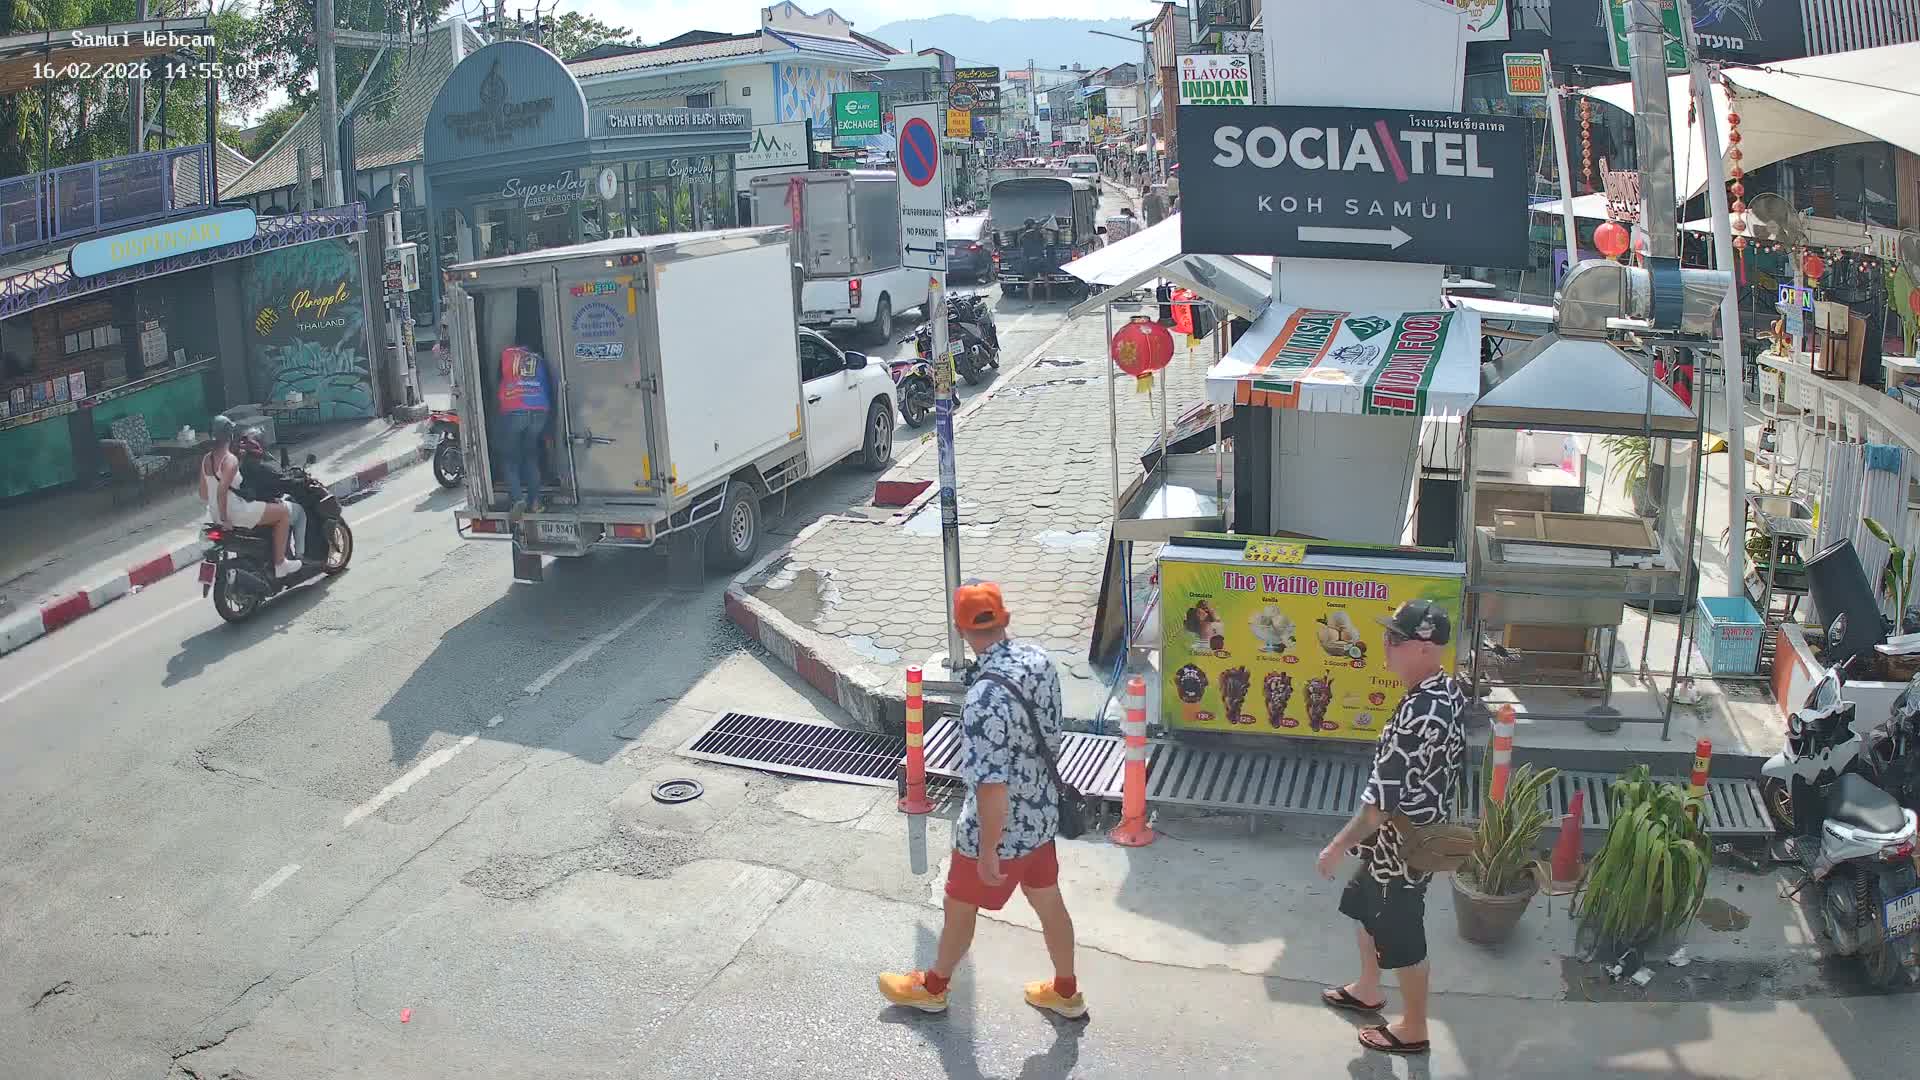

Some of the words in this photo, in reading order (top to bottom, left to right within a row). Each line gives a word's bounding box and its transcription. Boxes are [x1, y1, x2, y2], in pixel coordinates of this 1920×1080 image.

[1183, 68, 1248, 80] FLAVORS
[1507, 65, 1542, 77] INDIAN
[1182, 81, 1248, 97] INDIAN
[1511, 79, 1541, 90] FOOD
[609, 114, 654, 128] CHAWENG
[656, 114, 690, 126] GARDEN
[692, 113, 717, 125] BEACH
[719, 113, 745, 125] RESORT
[838, 120, 878, 130] EXCHANGE
[1408, 114, 1505, 131] โรงแรมโซเชียลเทล
[1258, 195, 1323, 213] KOH
[1345, 198, 1452, 219] SAMUI
[914, 228, 938, 238] PARKING
[111, 223, 222, 262] DISPENSARY
[299, 318, 345, 331] THAILAND
[1223, 571, 1256, 591] The
[1262, 574, 1318, 595] Waffle
[1323, 579, 1388, 600] nutella
[1189, 591, 1213, 599] Chocolate
[1326, 601, 1346, 609] Coconut
